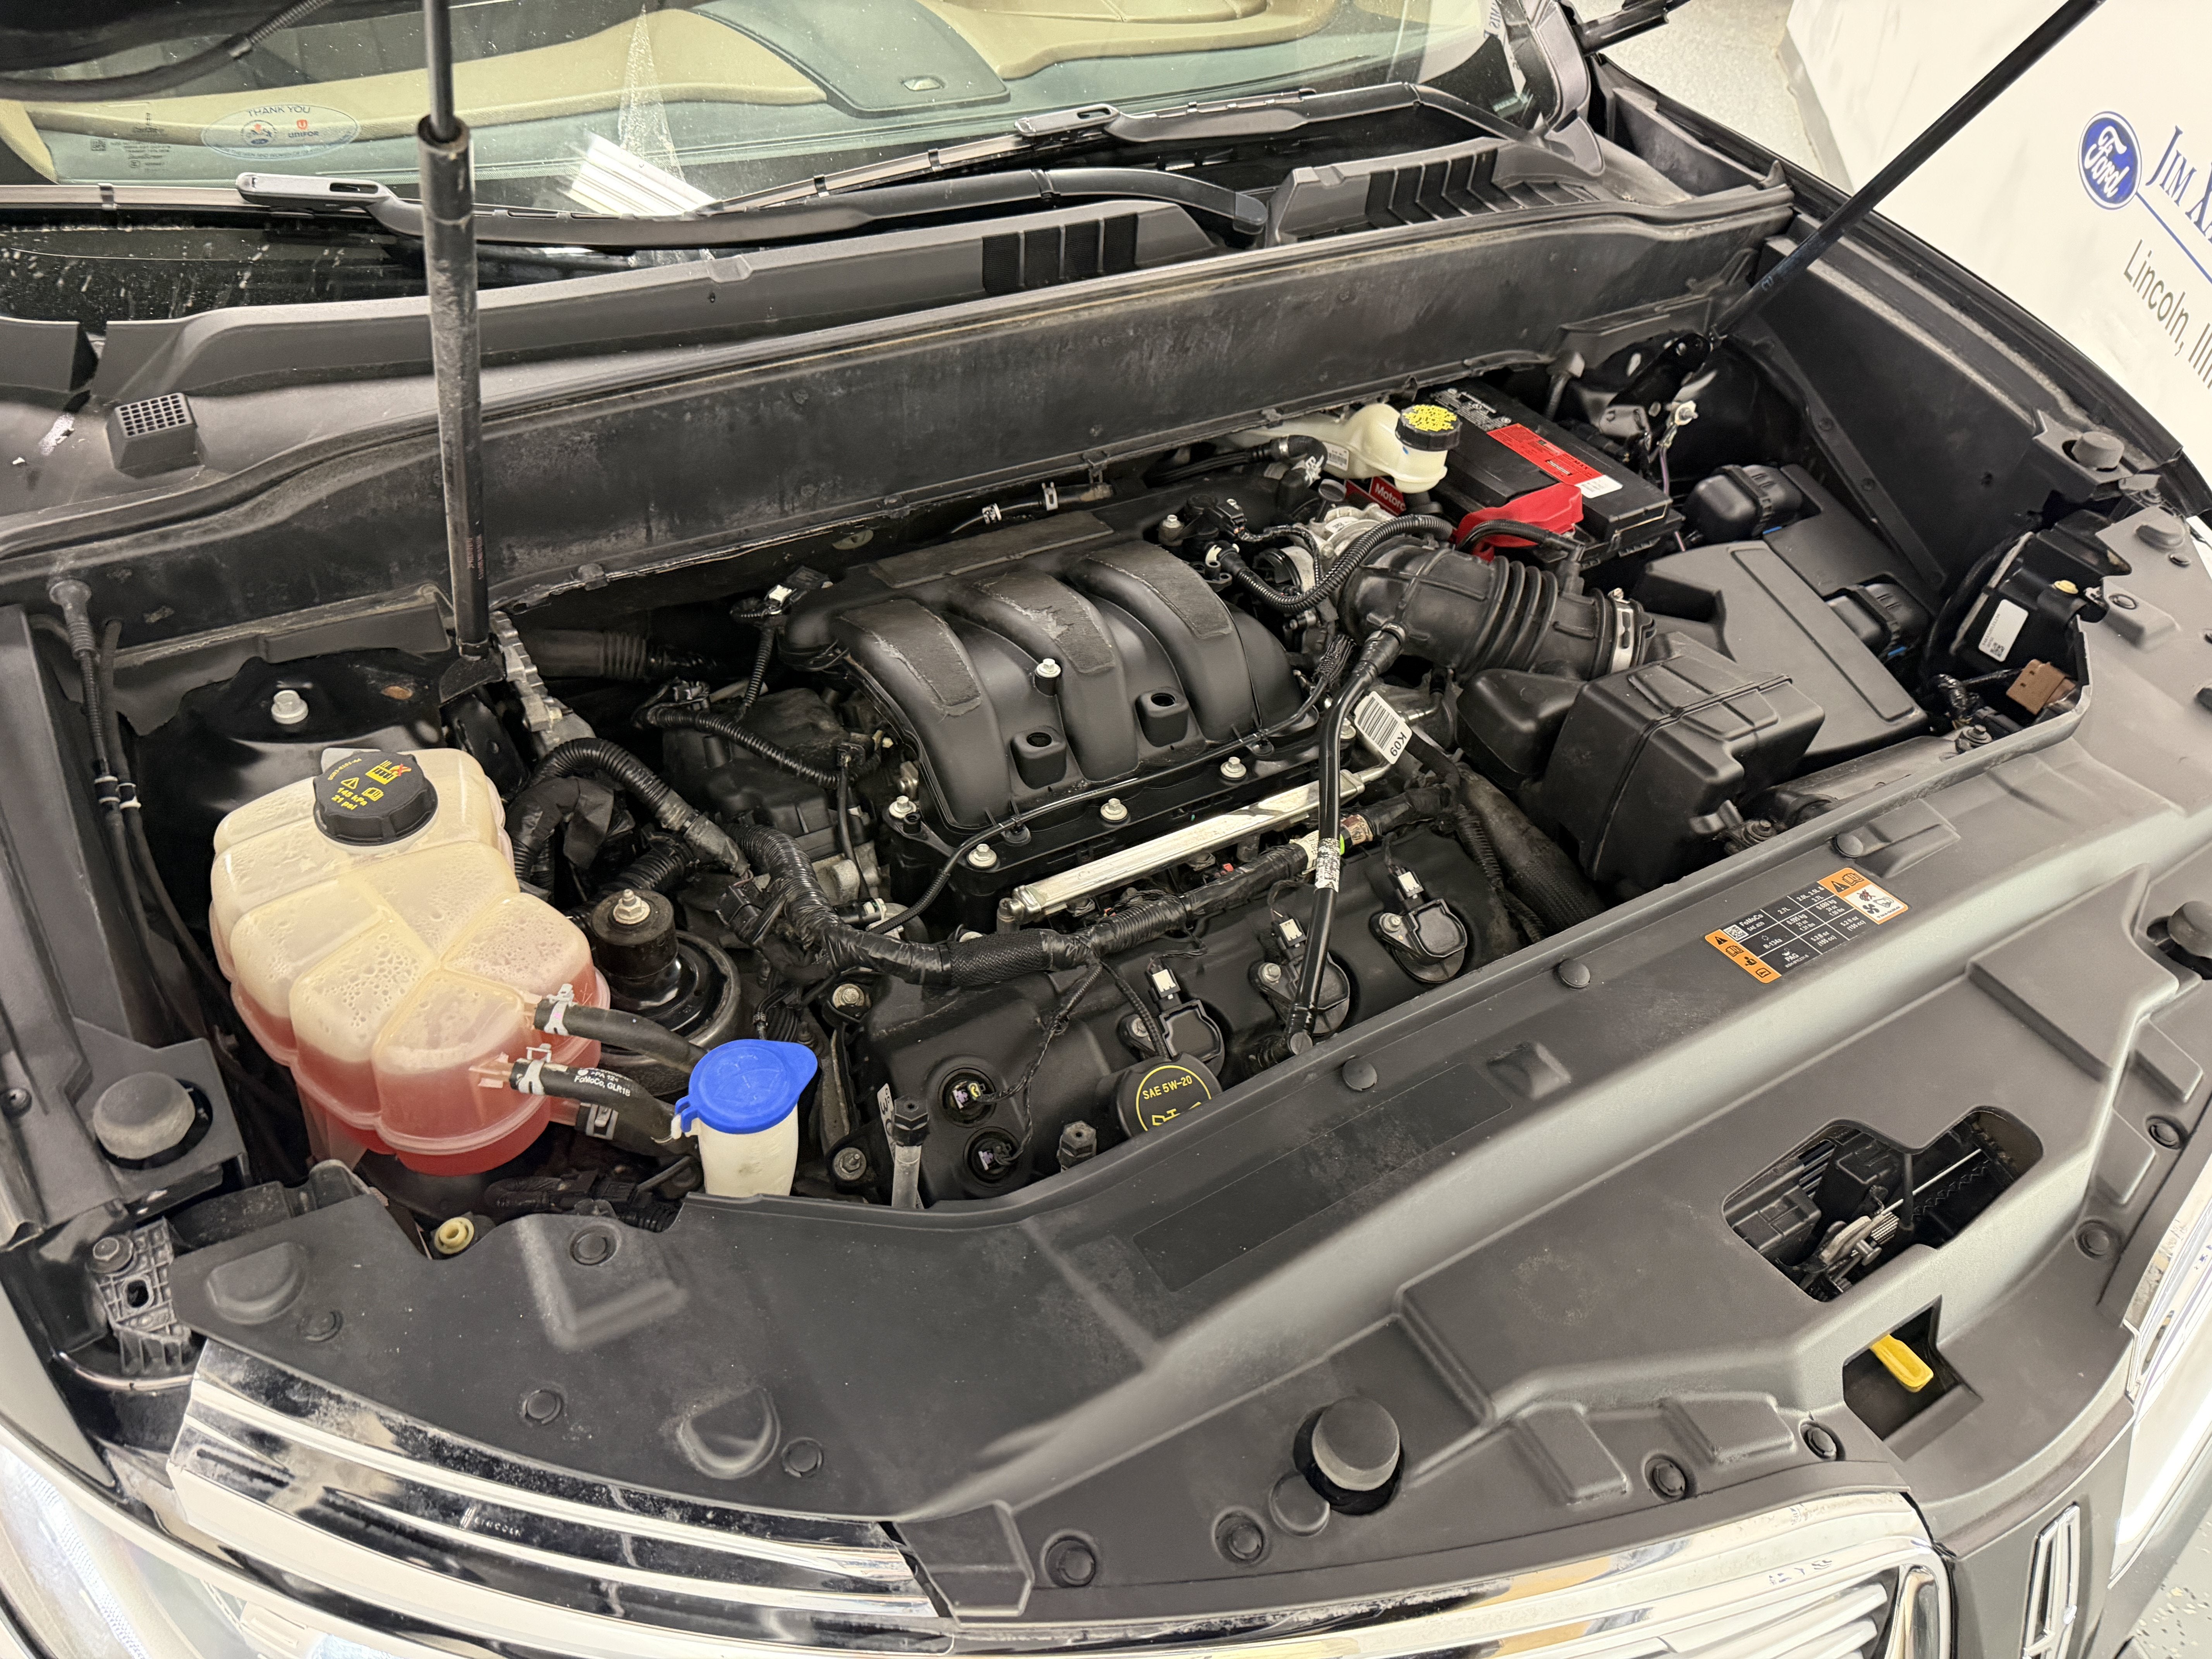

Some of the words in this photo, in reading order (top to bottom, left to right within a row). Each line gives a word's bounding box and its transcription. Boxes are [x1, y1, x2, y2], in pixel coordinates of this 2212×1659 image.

[249, 106, 285, 117] THANK
[2084, 126, 2130, 198] Ford
[2145, 125, 2197, 207] JIM
[2124, 239, 2189, 357] Lincoln,
[1390, 732, 1407, 756] K09
[331, 795, 344, 803] 21
[341, 802, 358, 811] psi
[351, 795, 368, 806] kPa
[1739, 913, 1764, 926] FoMoCo
[1763, 938, 1783, 949] R-134a
[1784, 953, 1799, 961] PAG
[574, 1075, 605, 1088] FoMoCo,
[1142, 1086, 1162, 1099] SAE
[1162, 1075, 1193, 1093] 5W-20
